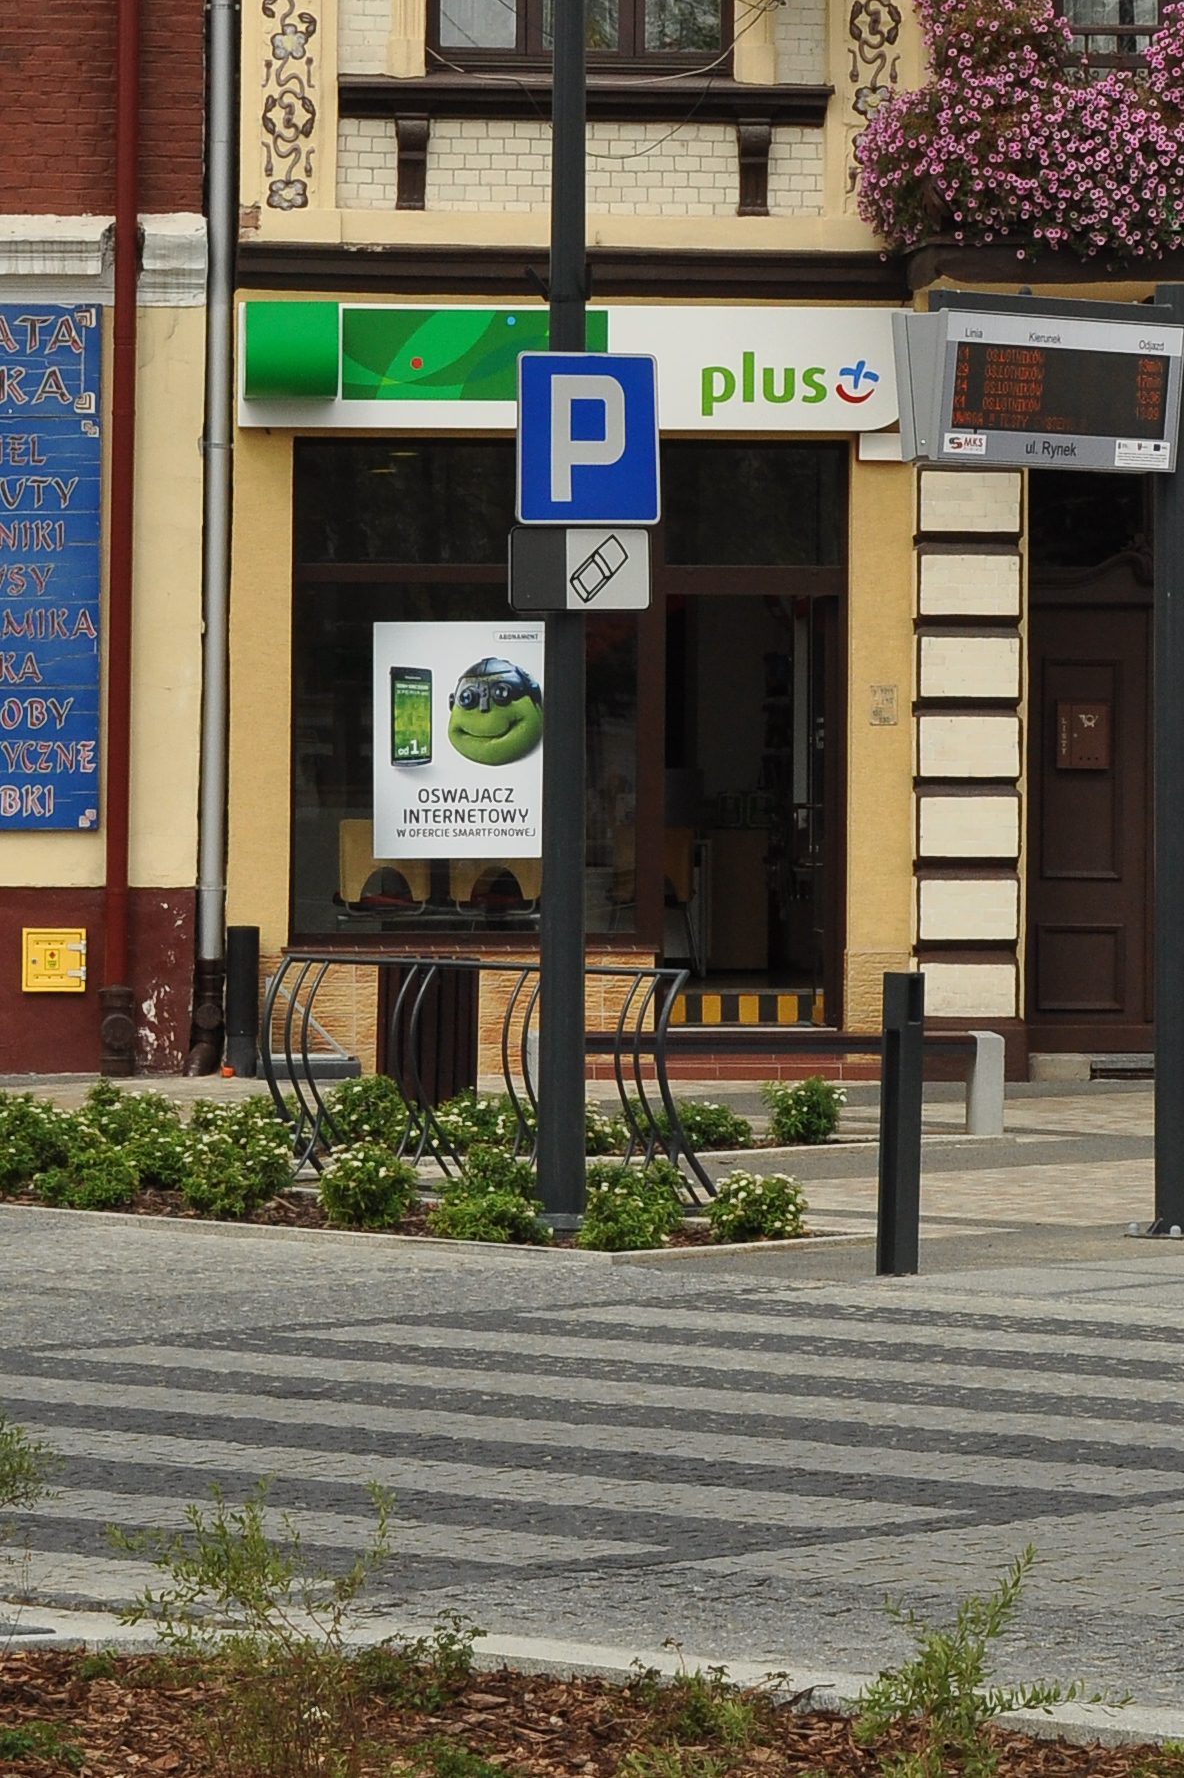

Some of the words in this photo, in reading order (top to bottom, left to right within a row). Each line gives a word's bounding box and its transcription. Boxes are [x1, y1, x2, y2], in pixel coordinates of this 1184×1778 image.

[964, 327, 983, 338] Linia
[1028, 332, 1062, 344] Kierunek
[1138, 339, 1164, 352] Odjazd
[702, 351, 827, 416] plus
[551, 375, 625, 502] P
[1025, 440, 1038, 455] ul.
[1041, 441, 1077, 459] Rynek
[397, 745, 409, 756] od
[410, 740, 419, 755] 1
[417, 788, 514, 804] OSWAJACZ
[403, 808, 529, 824] INTERNETOWY
[396, 828, 406, 838] W
[408, 828, 450, 838] OFERCIE
[452, 828, 536, 838] SMARTFONOWEJ
